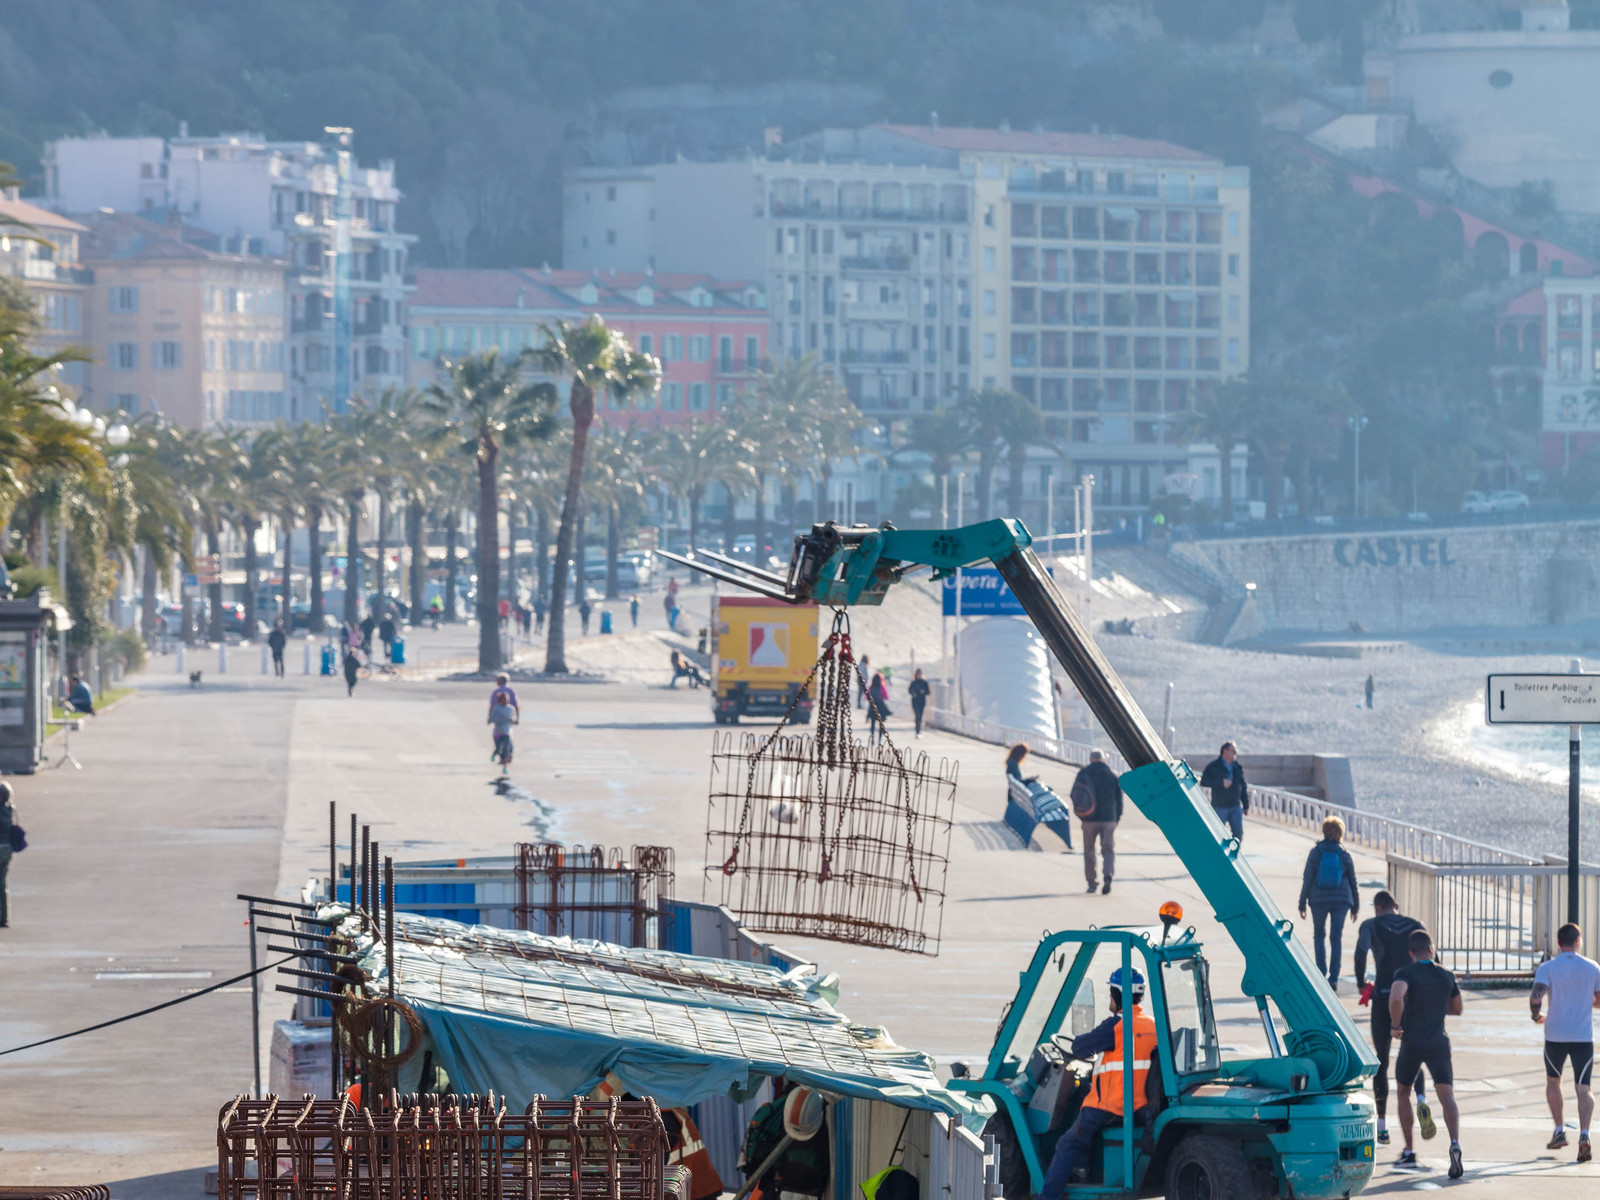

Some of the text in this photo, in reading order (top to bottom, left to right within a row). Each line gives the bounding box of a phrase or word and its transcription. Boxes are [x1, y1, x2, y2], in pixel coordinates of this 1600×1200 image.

[1333, 537, 1456, 567] CASTEL
[1513, 683, 1593, 692] Toilettes Publiqs
